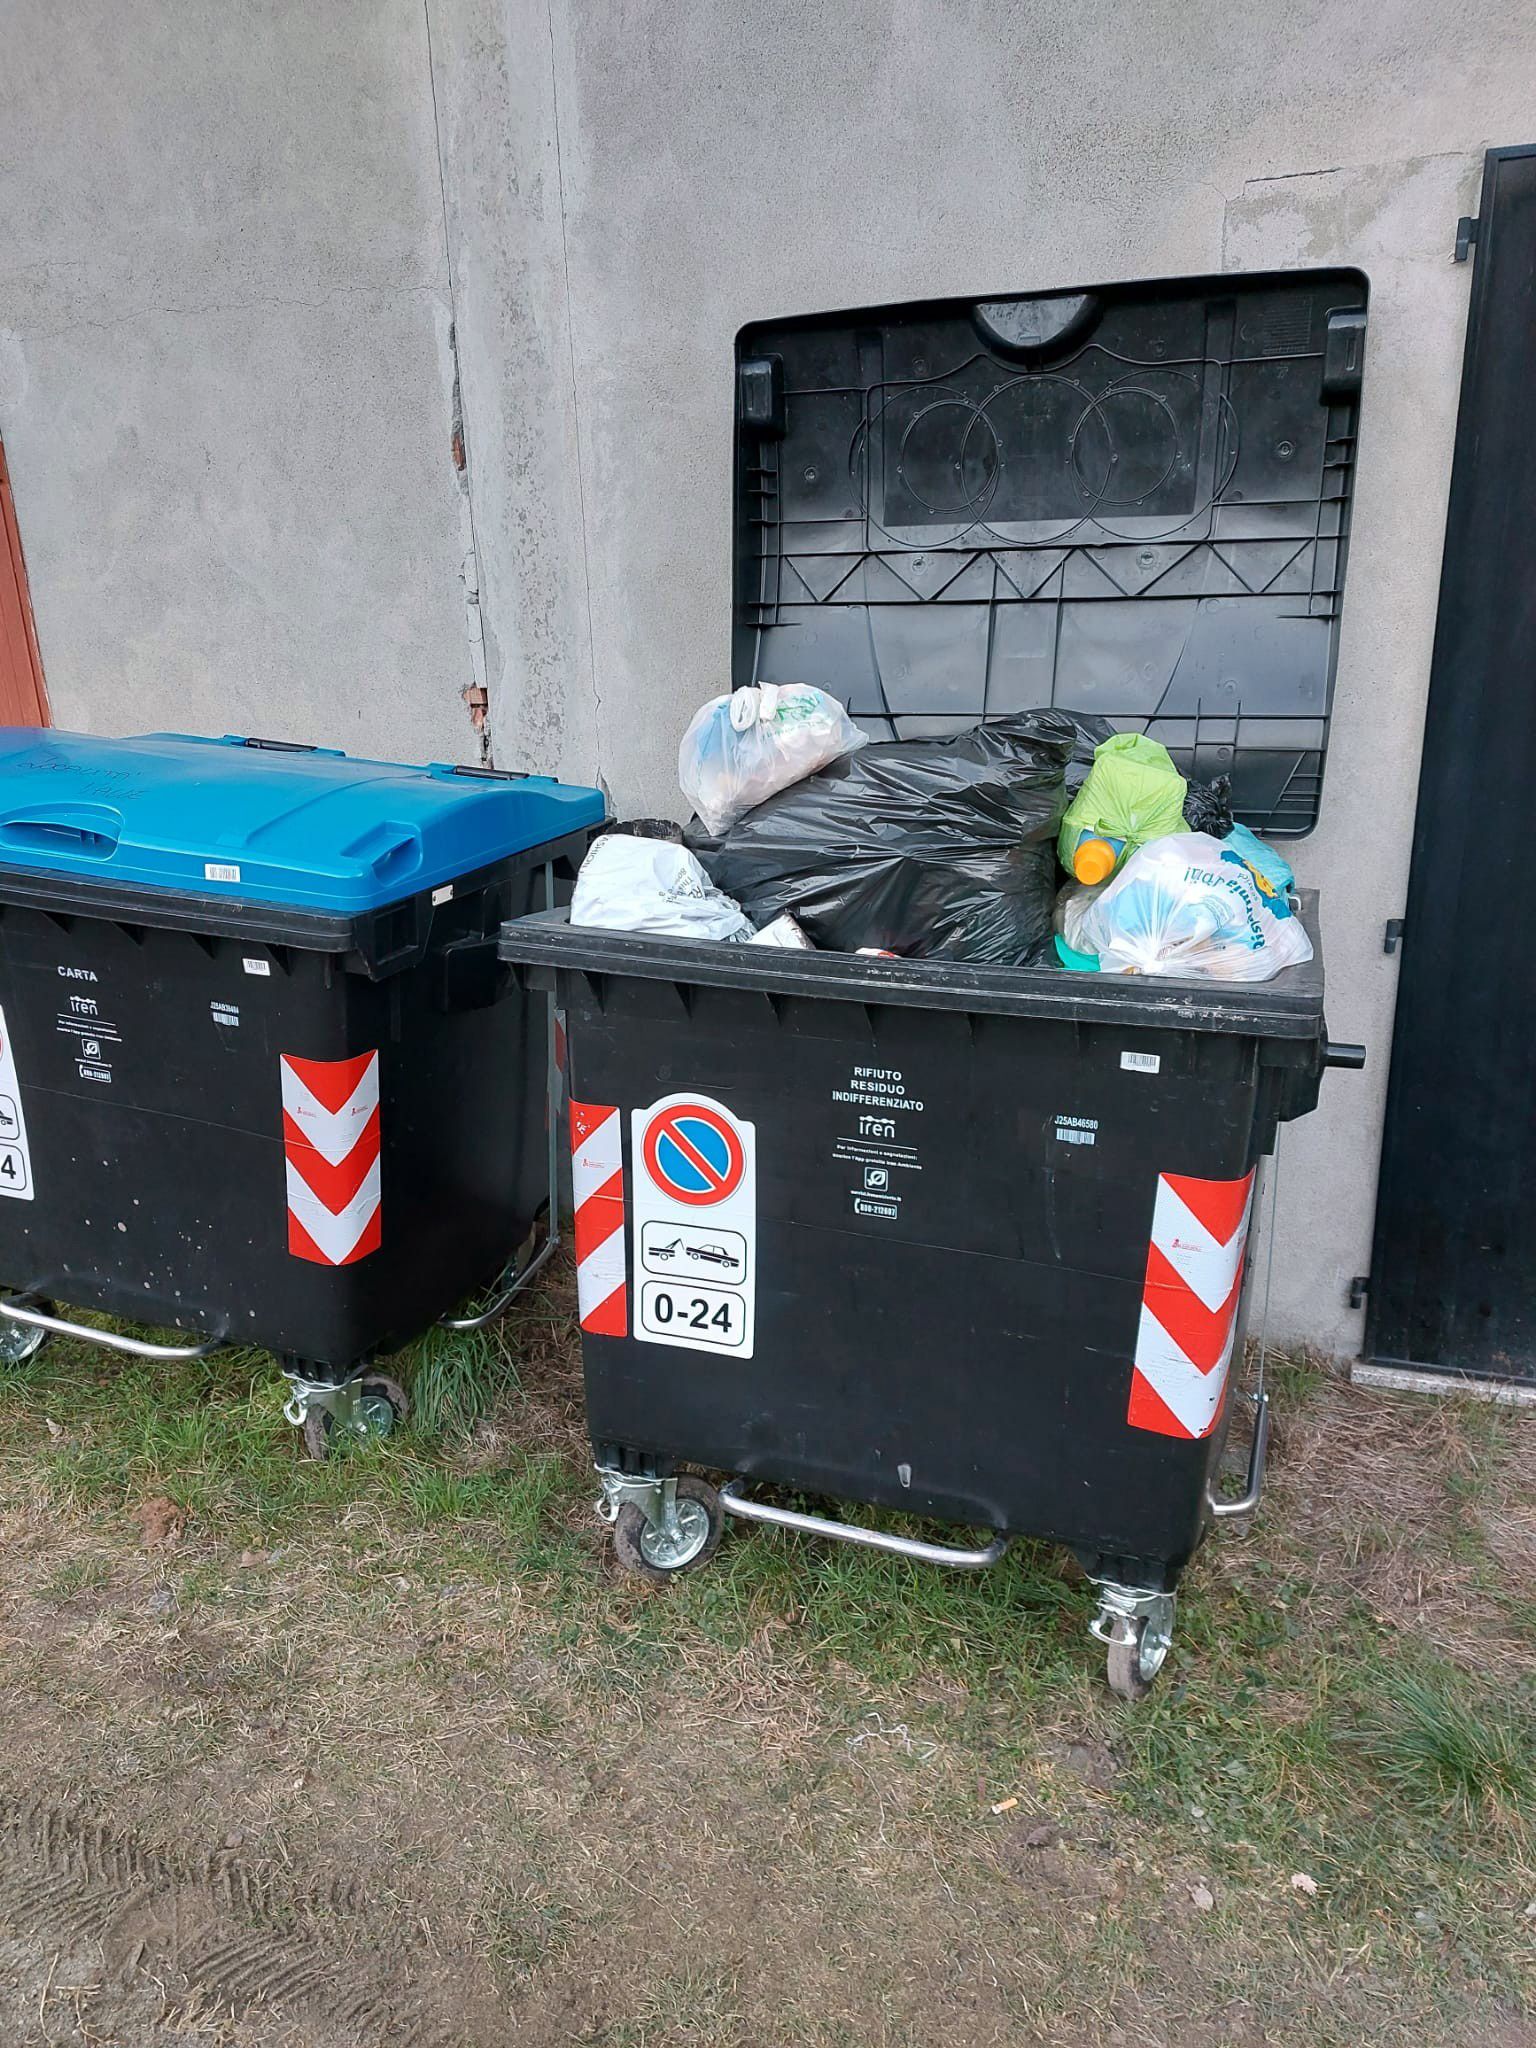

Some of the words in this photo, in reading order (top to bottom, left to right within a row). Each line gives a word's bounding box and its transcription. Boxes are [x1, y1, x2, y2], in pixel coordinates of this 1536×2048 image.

[57, 966, 99, 982] CARTA
[70, 996, 98, 1015] iren
[854, 1066, 902, 1081] RIFIUTO
[850, 1080, 905, 1095] RESIDUO
[832, 1090, 924, 1111] INDIFFERENZIATO
[859, 1115, 896, 1138] iren
[654, 1293, 733, 1333] 0-24
